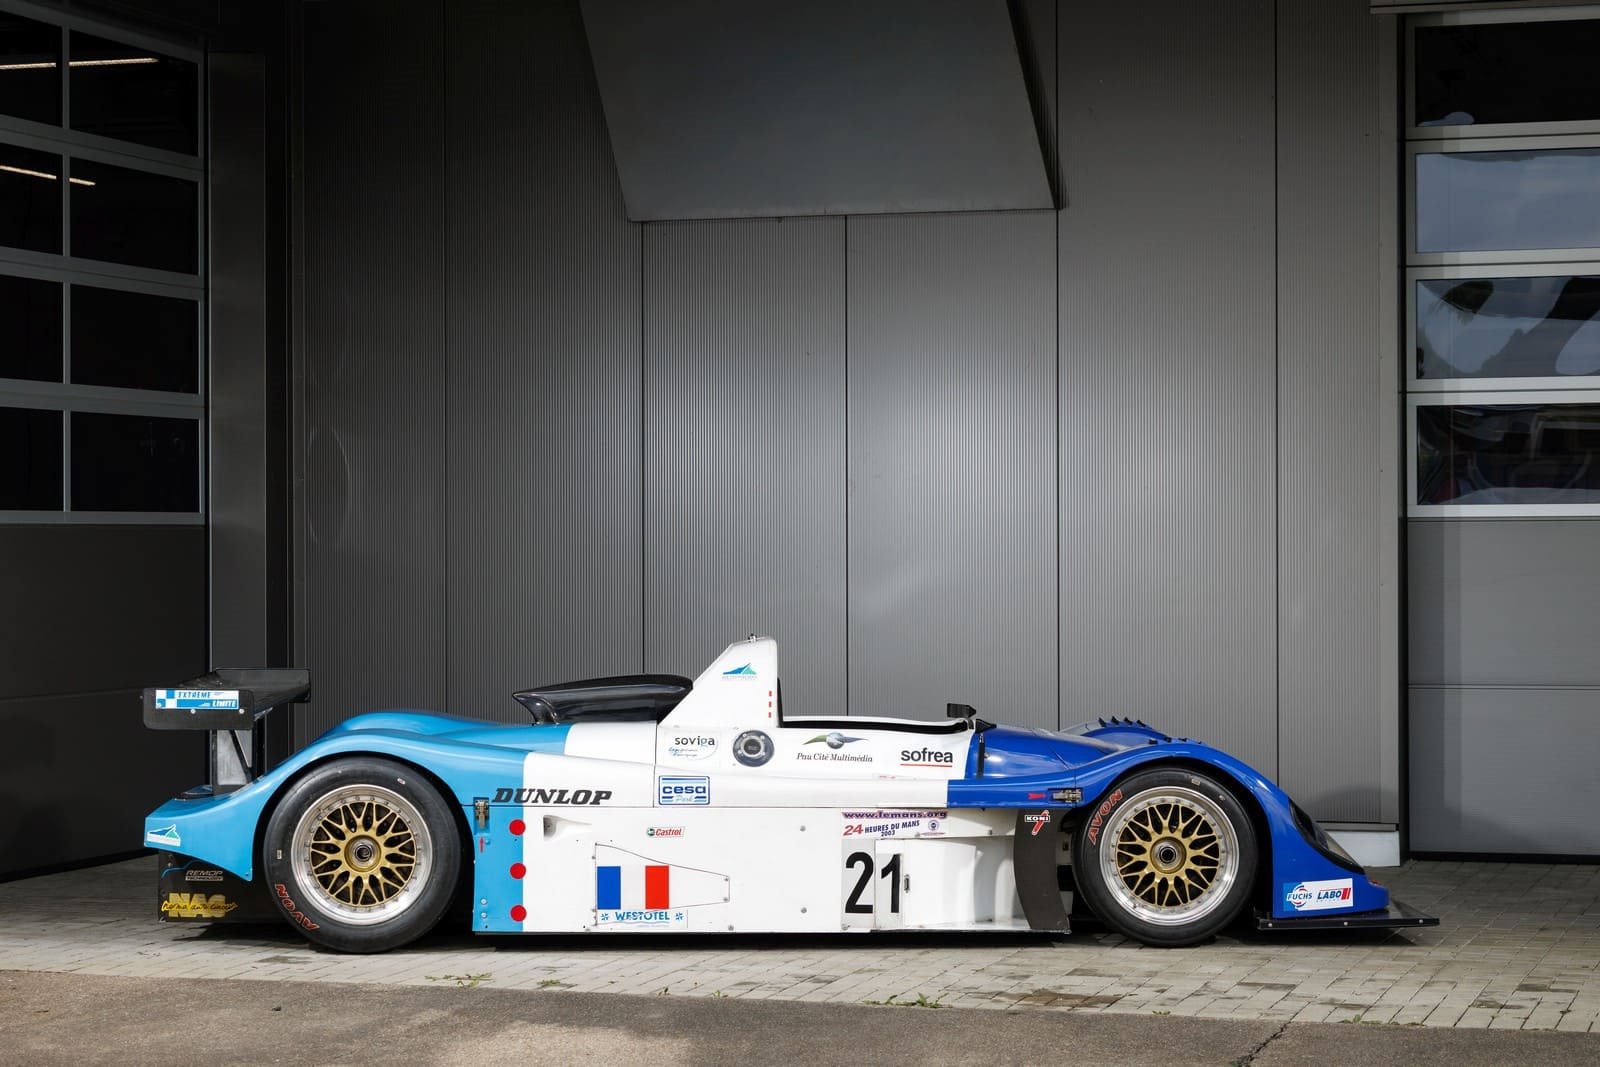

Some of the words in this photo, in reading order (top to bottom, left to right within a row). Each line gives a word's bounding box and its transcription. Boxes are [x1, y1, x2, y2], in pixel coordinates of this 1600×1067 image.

[178, 691, 211, 699] EXTREME
[212, 700, 236, 708] LIMITE
[674, 735, 715, 748] soviga
[900, 748, 953, 763] sofrea
[662, 785, 707, 794] cesa
[492, 787, 613, 805] DUNLOP
[841, 810, 948, 819] www.lemans.org
[1088, 789, 1123, 846] AVON
[655, 828, 682, 837] Castrol
[843, 824, 864, 836] 24
[864, 824, 889, 834] HEURES
[890, 822, 900, 830] DU
[901, 820, 920, 829] MANS
[845, 851, 901, 914] 21
[1287, 892, 1313, 900] FUCHS
[1317, 890, 1342, 900] LABO
[274, 883, 320, 931] AVON
[615, 911, 670, 921] WESTOTEL
